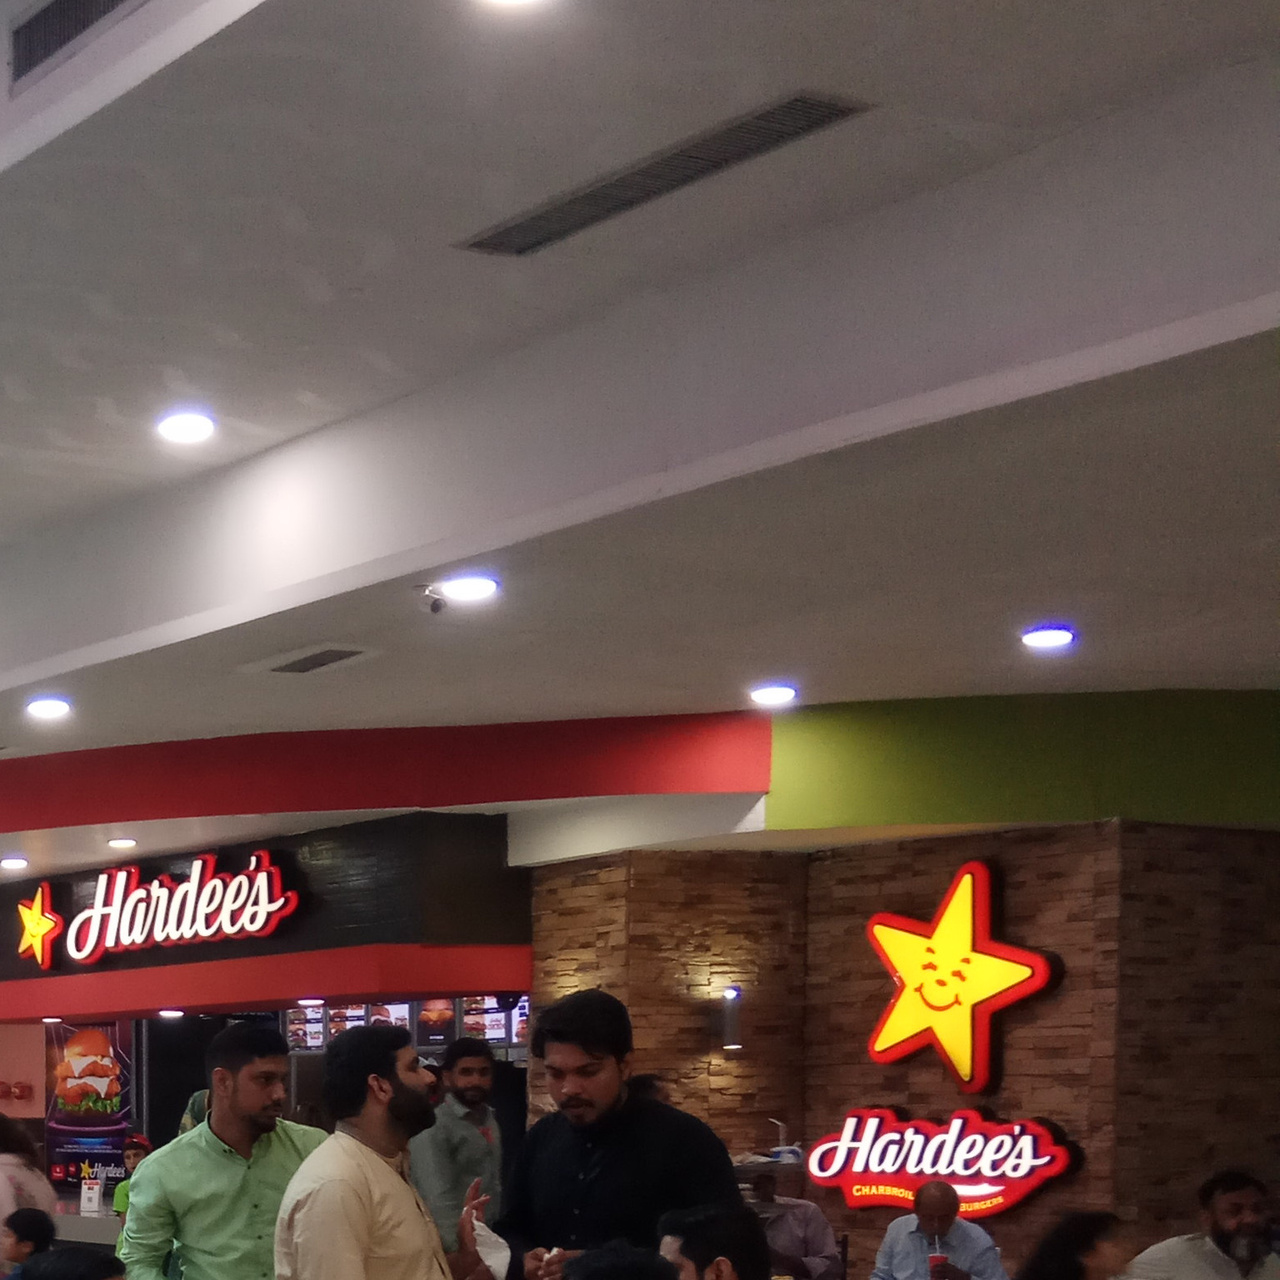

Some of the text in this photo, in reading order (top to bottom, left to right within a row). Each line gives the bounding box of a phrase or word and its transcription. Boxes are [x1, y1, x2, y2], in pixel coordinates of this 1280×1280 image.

[66, 852, 290, 962] Hardee's
[808, 1117, 1052, 1178] Hardee's
[852, 1184, 915, 1201] CHARBROIL
[959, 1196, 1004, 1212] BURGERS
